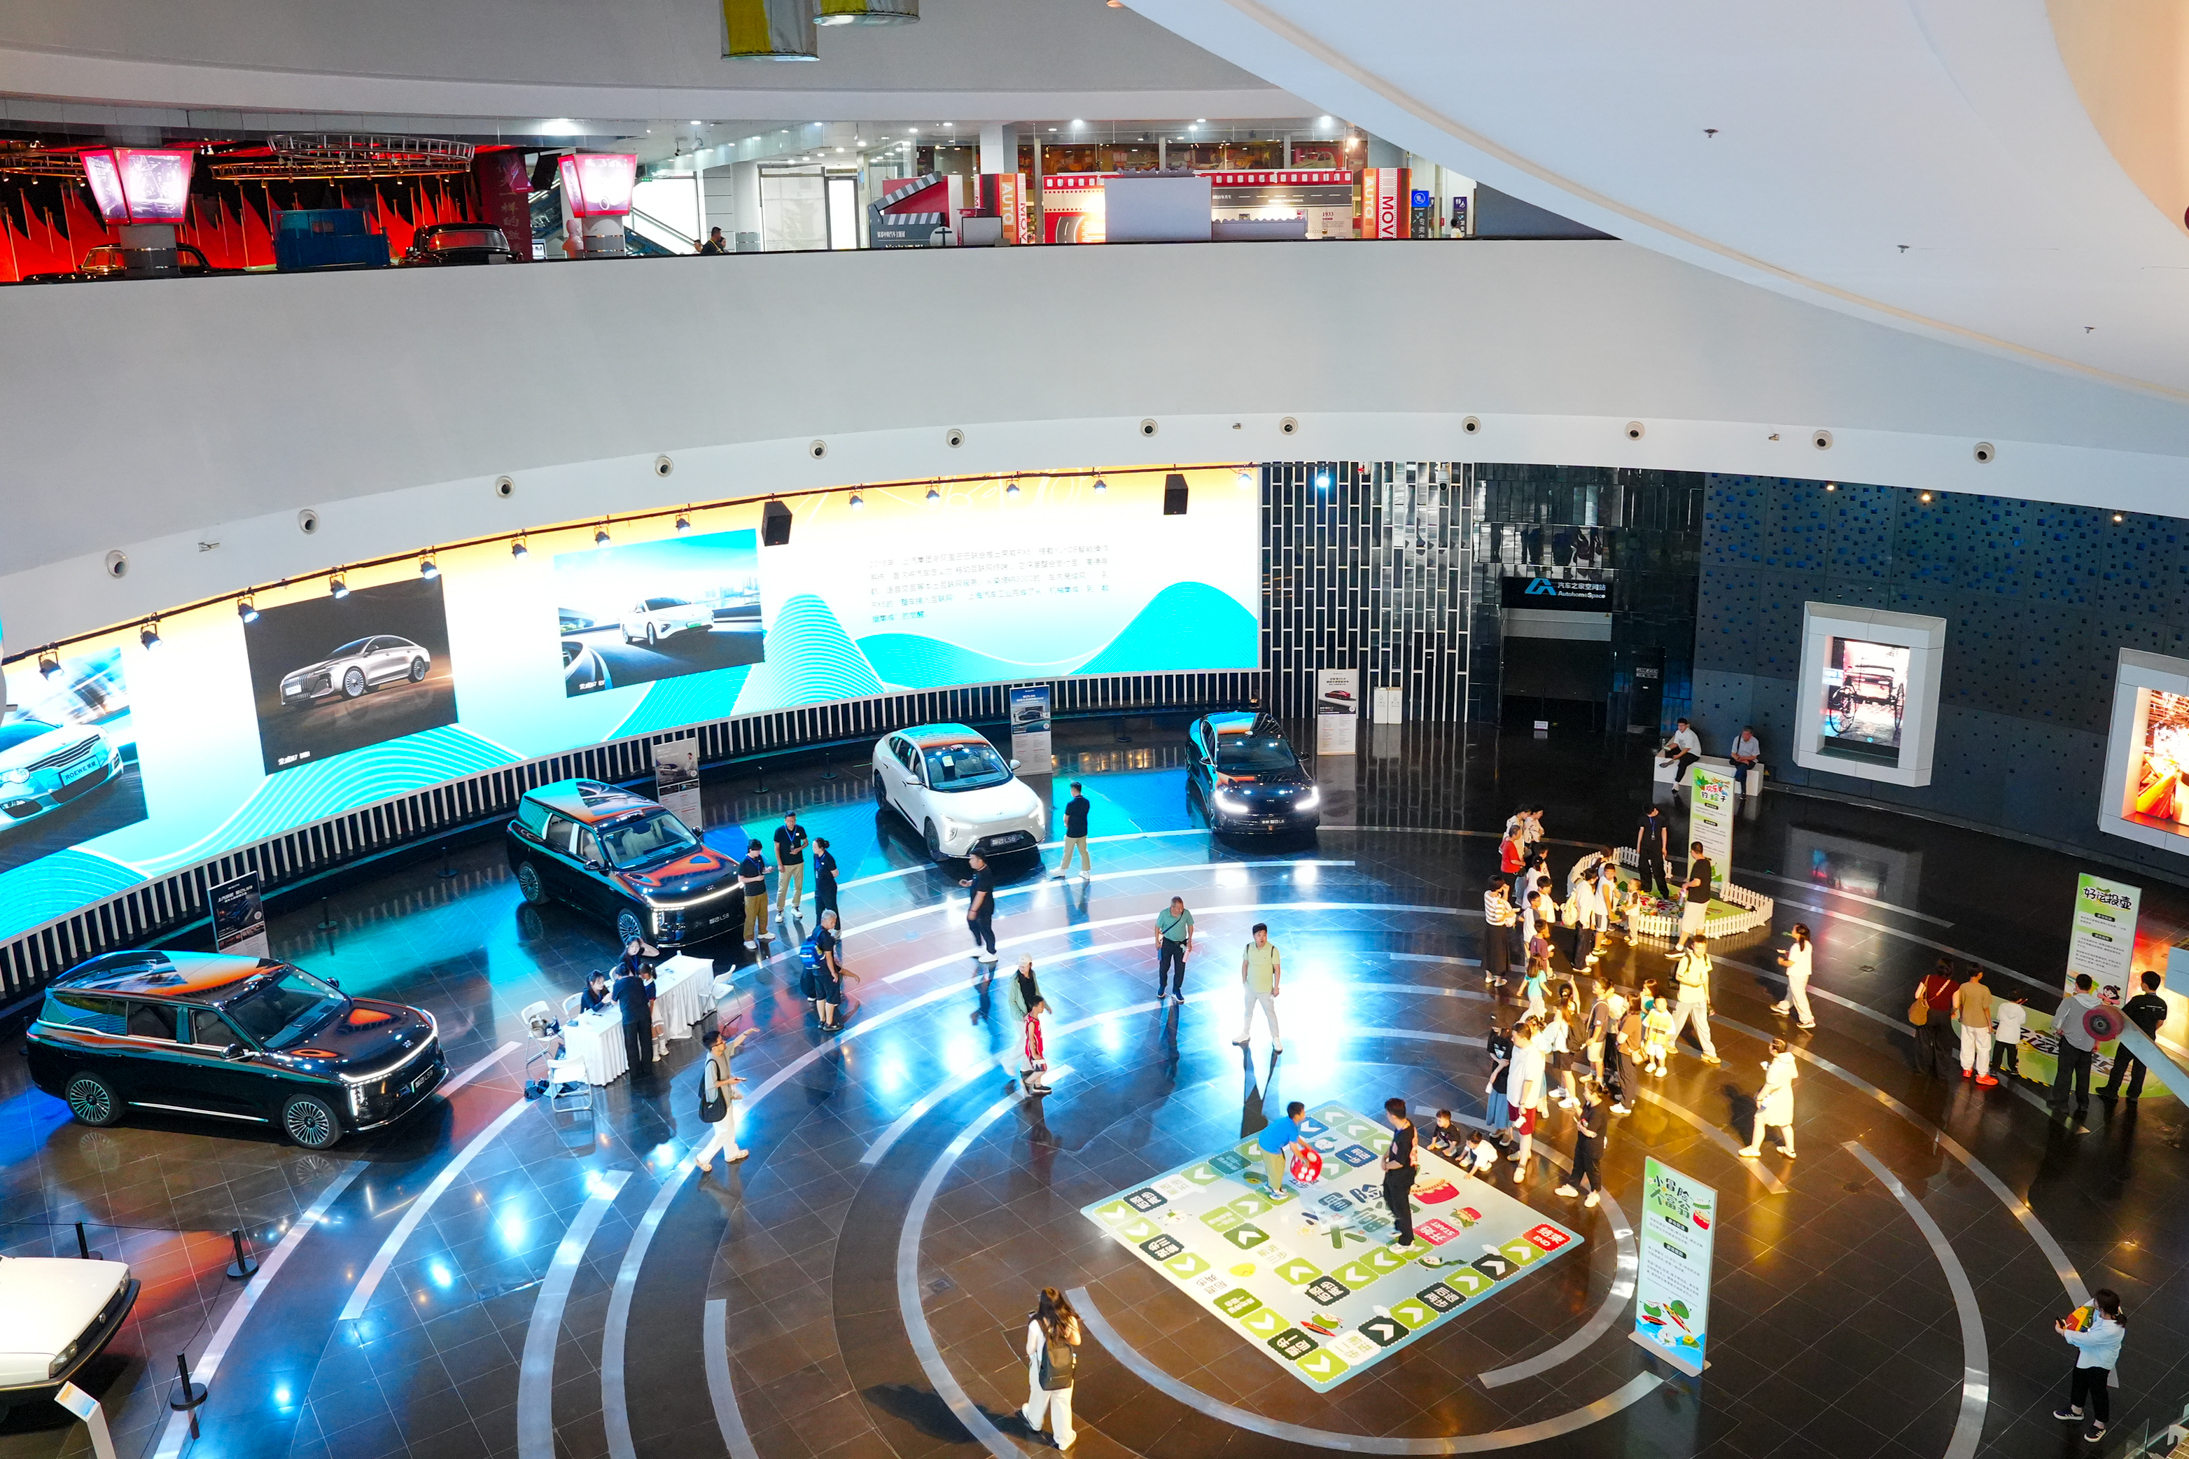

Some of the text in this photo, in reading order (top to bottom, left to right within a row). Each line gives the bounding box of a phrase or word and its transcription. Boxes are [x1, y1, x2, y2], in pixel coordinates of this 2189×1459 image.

[1002, 183, 1013, 224] AUTO
[1365, 178, 1374, 218] AUTO
[1557, 582, 1606, 591] 汽车之家空间站
[65, 766, 87, 780] ROEWE
[2083, 887, 2132, 910] 好运投壶
[1654, 1175, 1690, 1202] 小冒险
[1650, 1187, 1691, 1219] 大富翁
[1417, 1225, 1447, 1242] 开始
[1429, 1220, 1455, 1235] START
[1535, 1226, 1567, 1244] 结束
[1532, 1235, 1552, 1246] END
